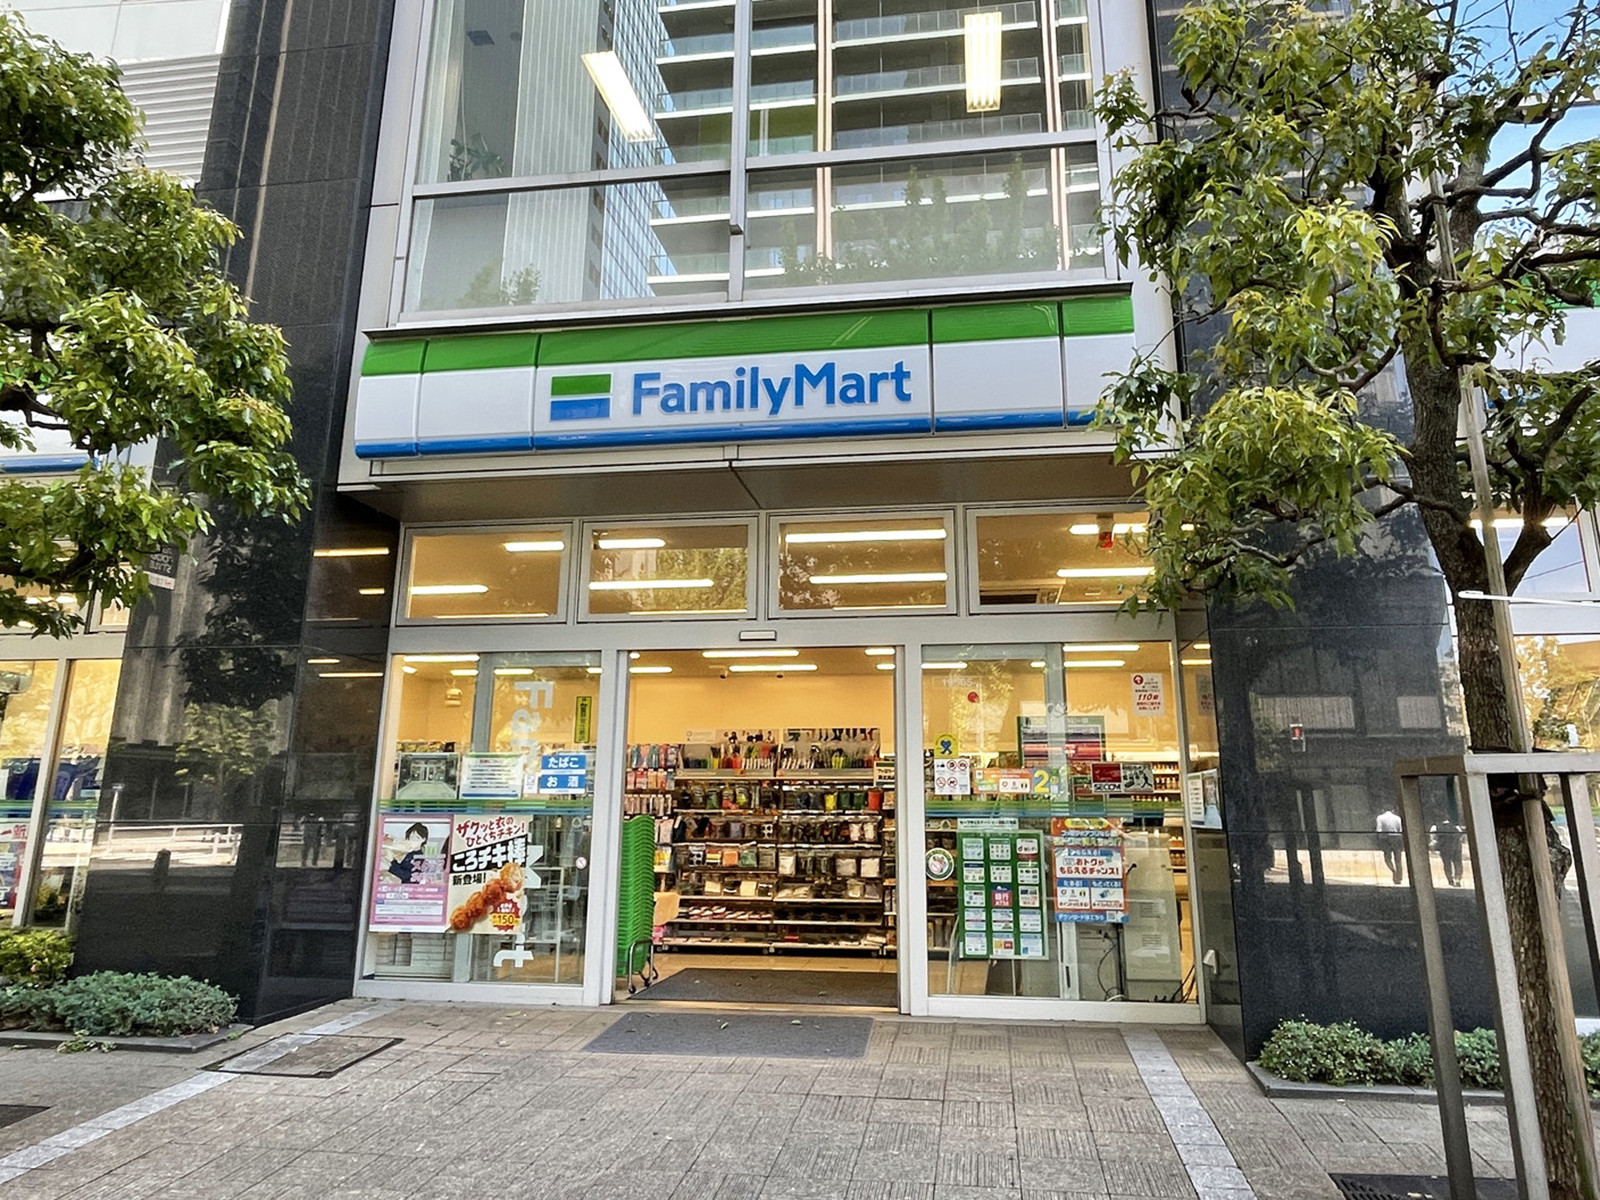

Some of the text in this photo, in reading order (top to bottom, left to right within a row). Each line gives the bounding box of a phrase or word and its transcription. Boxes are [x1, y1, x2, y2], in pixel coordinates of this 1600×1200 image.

[632, 360, 912, 417] FamilyMart
[548, 756, 579, 768] たばこ
[1033, 769, 1050, 793] 2
[1093, 783, 1121, 791] SECOM
[452, 837, 526, 872] ころチキ棒
[452, 872, 487, 886] 新登場!
[497, 914, 515, 925] 150
